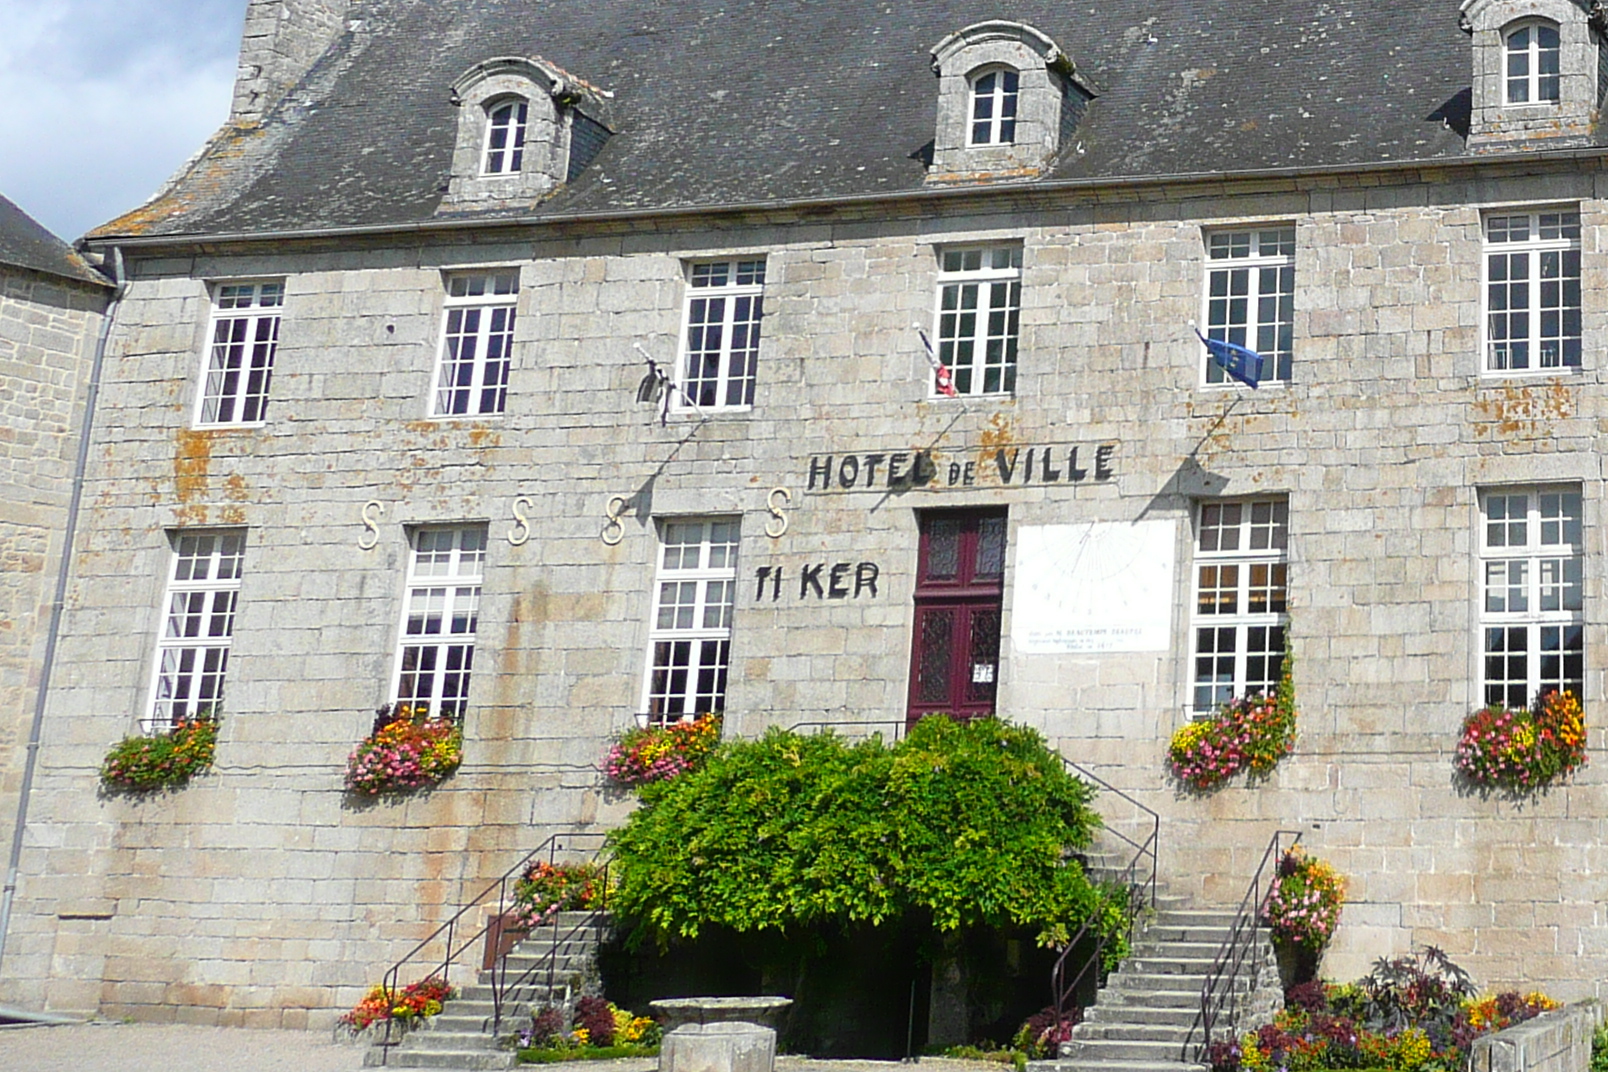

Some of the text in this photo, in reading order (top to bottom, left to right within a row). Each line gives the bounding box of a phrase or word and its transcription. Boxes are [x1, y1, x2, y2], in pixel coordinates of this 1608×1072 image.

[807, 445, 1115, 490] HOTEL DE VILLE
[755, 561, 880, 602] TI KER
